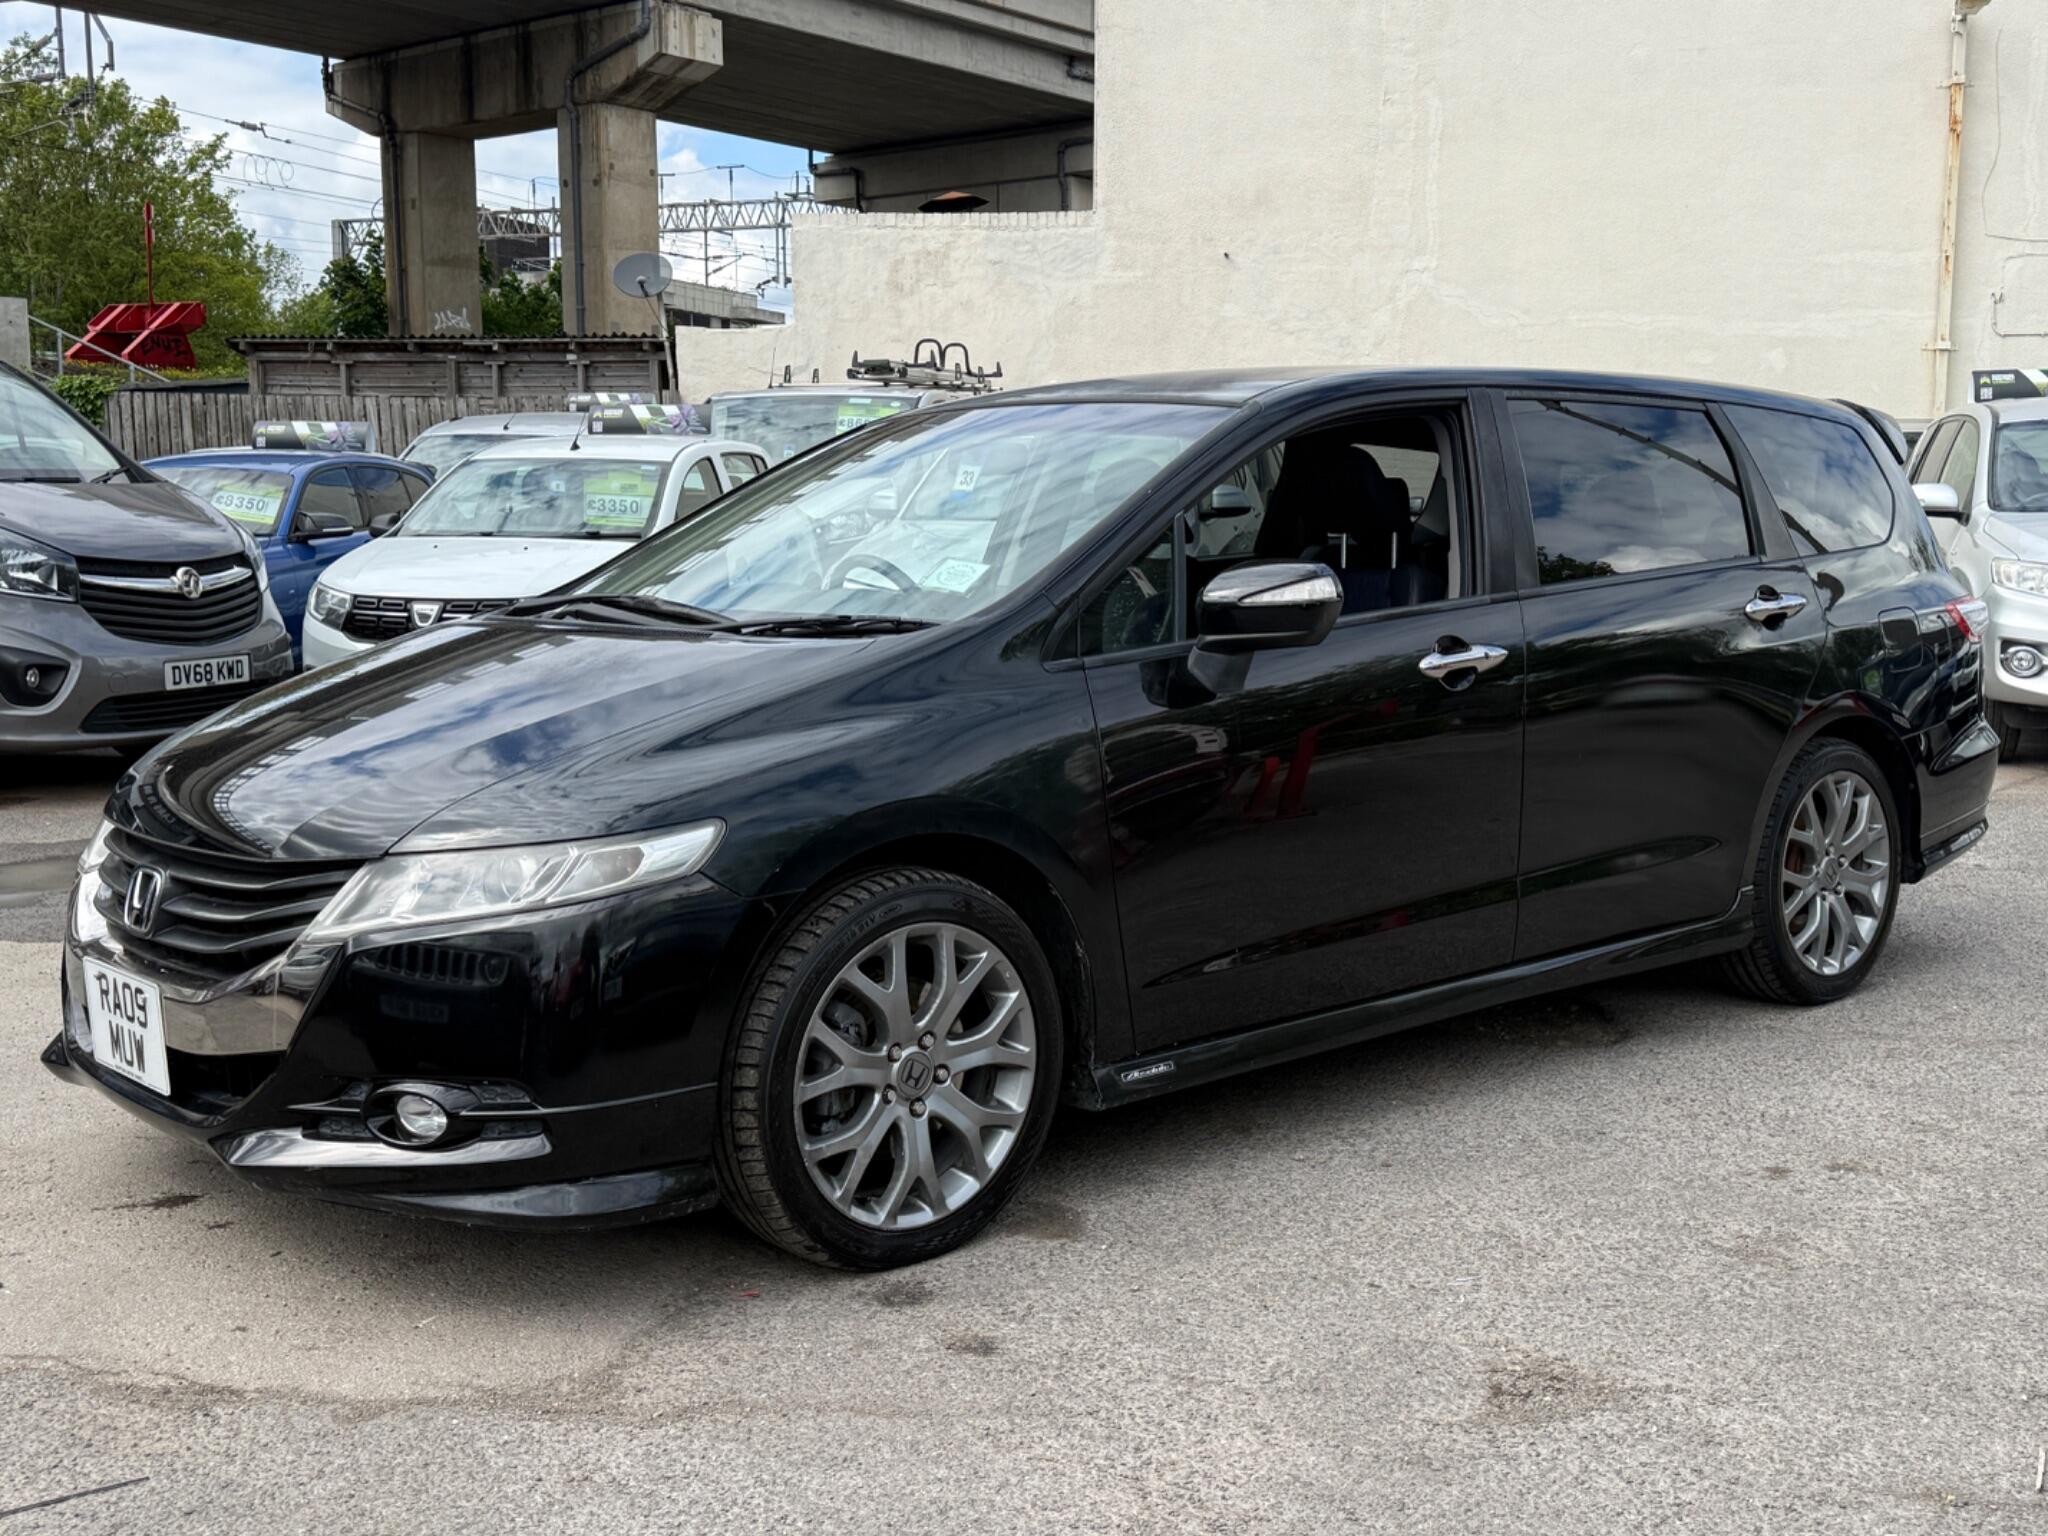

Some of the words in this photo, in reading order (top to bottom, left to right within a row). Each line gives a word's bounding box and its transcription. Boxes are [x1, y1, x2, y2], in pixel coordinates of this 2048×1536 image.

[215, 495, 266, 511] £8350
[587, 498, 639, 514] £3350
[172, 663, 213, 685] DV68
[217, 659, 244, 681] KWD
[98, 971, 148, 1029] RA09
[109, 1019, 145, 1074] MUW
